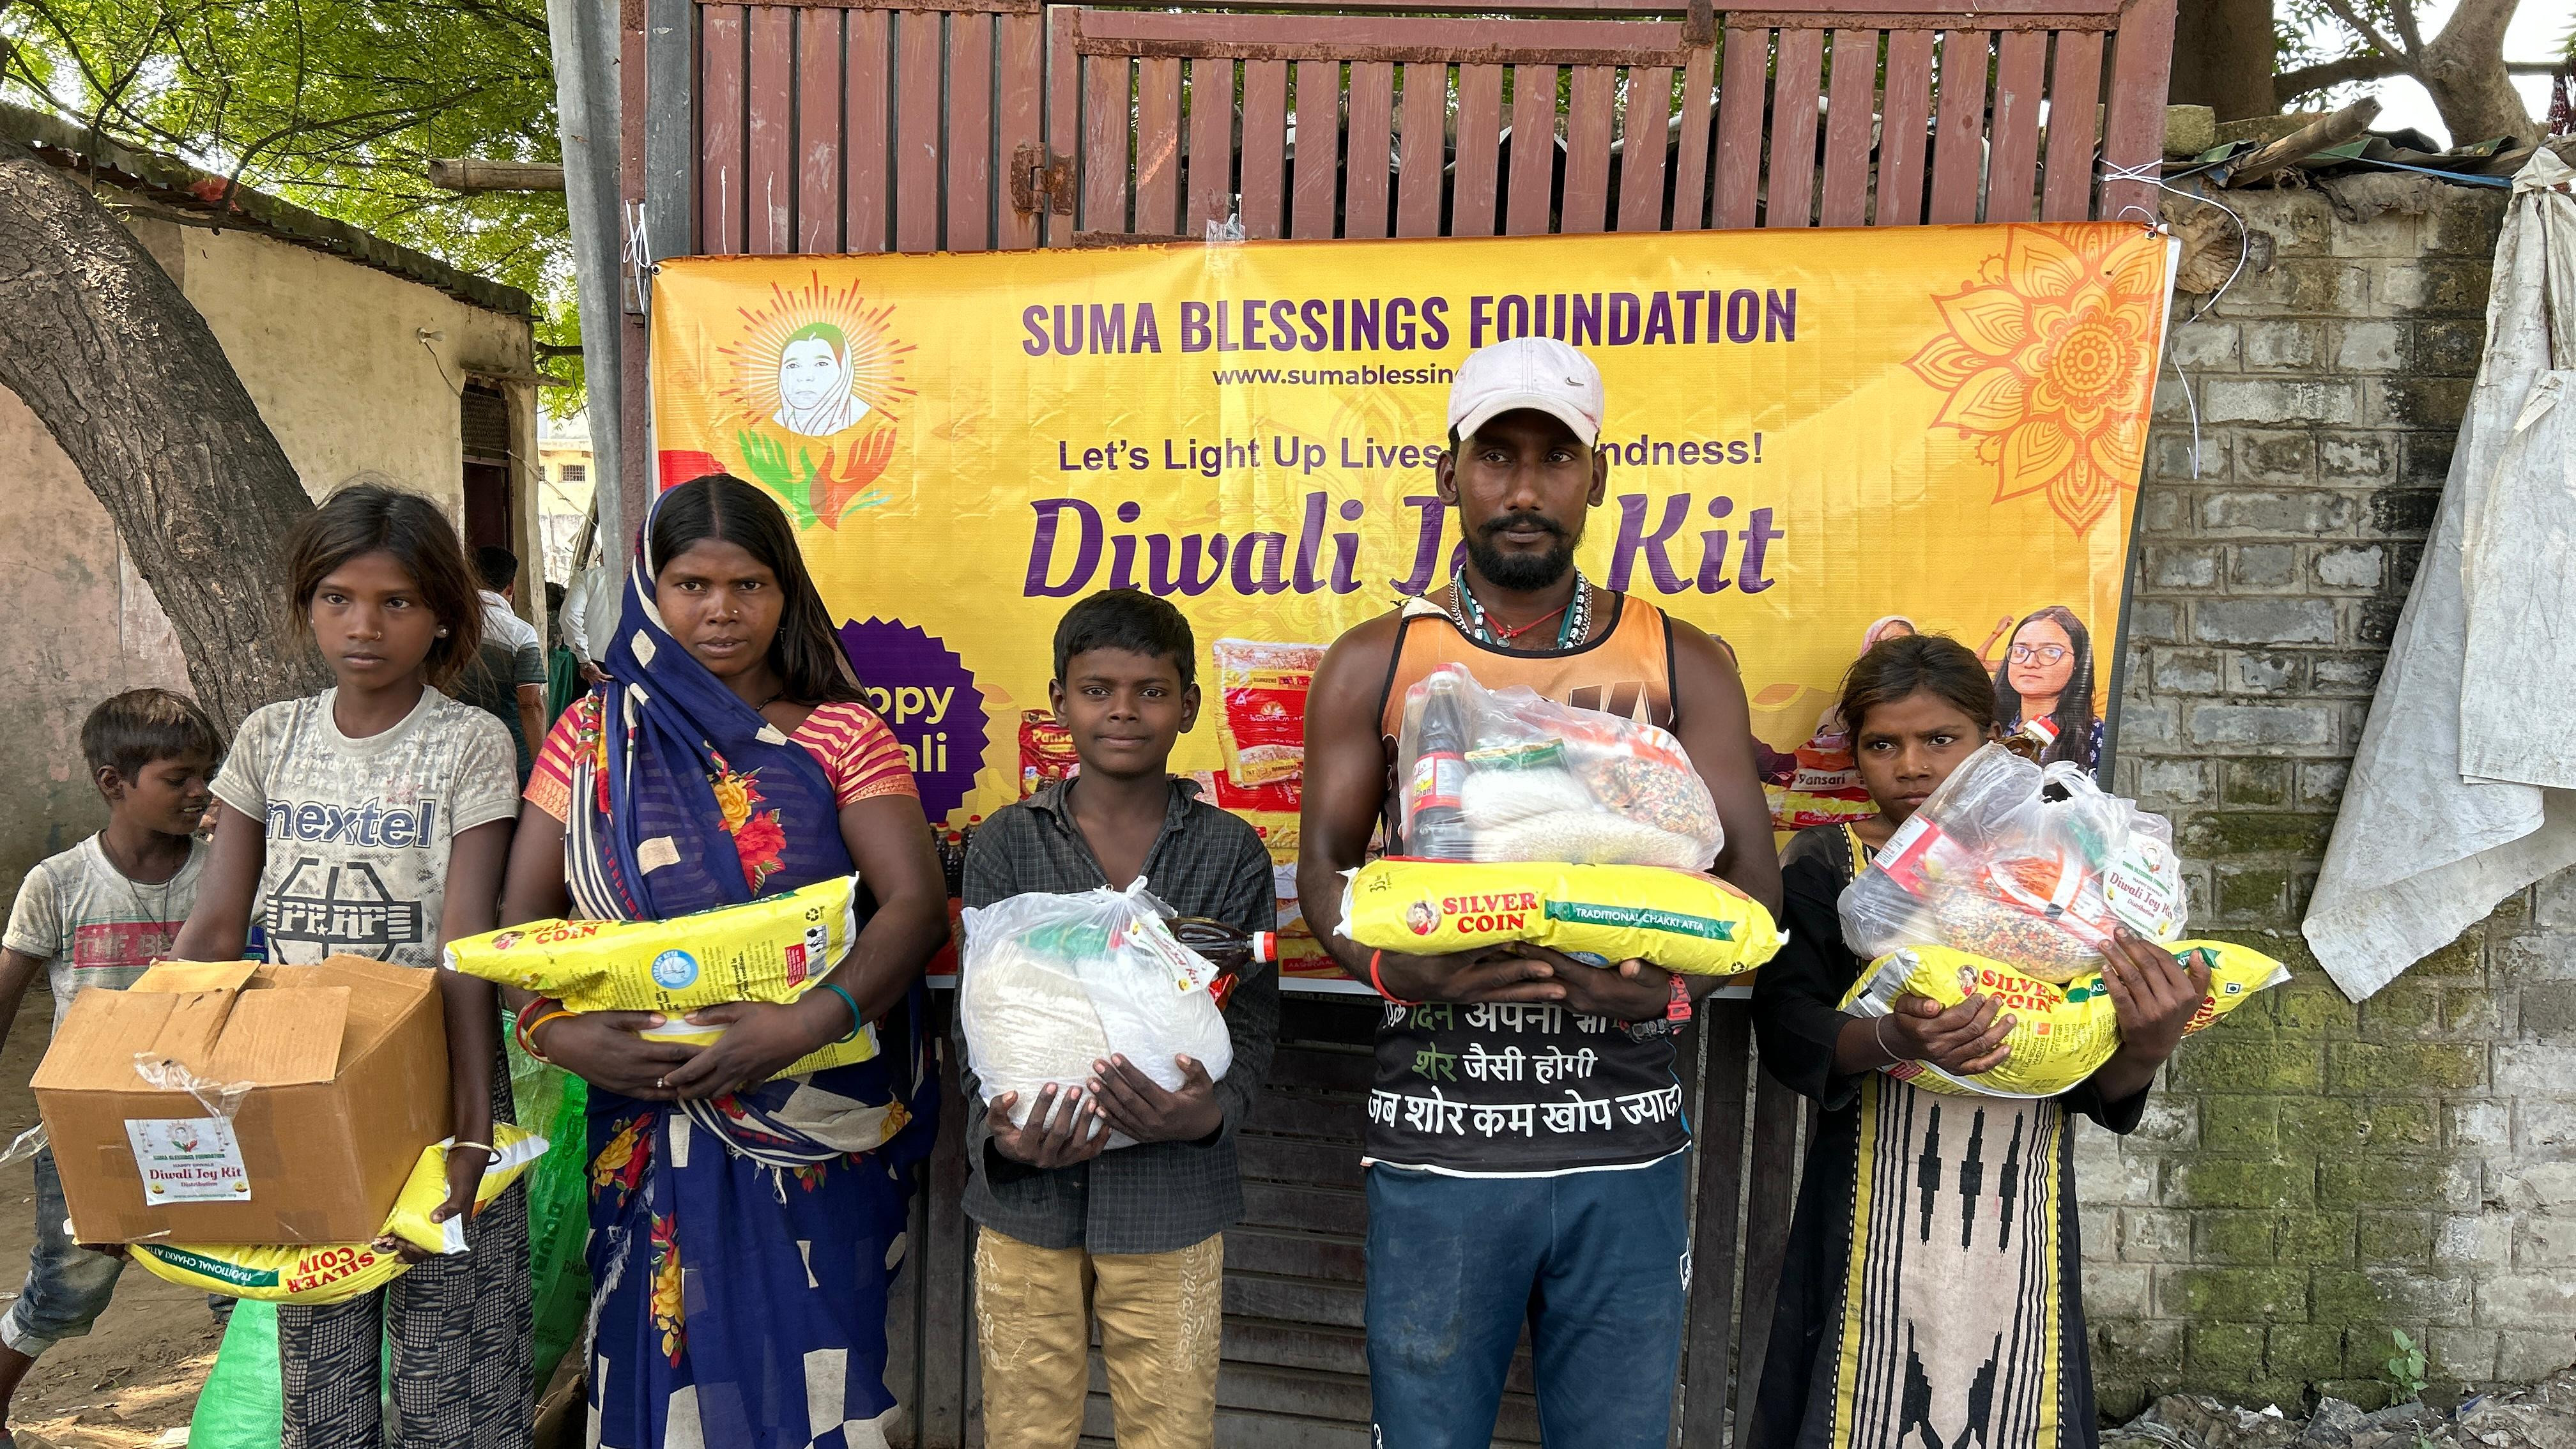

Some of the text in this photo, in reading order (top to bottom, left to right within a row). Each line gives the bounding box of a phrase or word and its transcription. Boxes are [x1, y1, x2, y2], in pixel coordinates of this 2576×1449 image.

[1022, 288, 1797, 356] SUMA BLESSINGS FOUNDATION
[1213, 363, 1459, 386] www.sumablessin
[1164, 438, 1261, 478] Light
[1273, 436, 1326, 475] Up
[1340, 437, 1440, 468] Lives
[1604, 433, 1763, 466] ndness!
[1023, 491, 1363, 597] Diwali
[1607, 493, 1784, 595] Kit
[1032, 729, 1074, 742] Pansa
[1798, 772, 1846, 786] Pansari
[266, 796, 436, 849] nextel
[2109, 871, 2144, 899] Diwali
[1442, 892, 1538, 915] SILVER
[1457, 914, 1526, 933] COIN
[1575, 907, 1705, 931] TRADITIONAL CHAKKI ATTA
[535, 925, 600, 944] COIN
[1981, 969, 2062, 1004] SILVER
[1411, 1041, 1598, 1084] शेर जैसी होगी
[1367, 1087, 1402, 1128] जब
[1404, 1085, 1468, 1136] शोर
[1469, 1103, 1536, 1138] कम
[149, 1166, 242, 1181] Diwali Joy Kit
[164, 1251, 197, 1267] CHAKKI
[286, 1250, 376, 1294] SILVER
[298, 1246, 356, 1276] COIN
